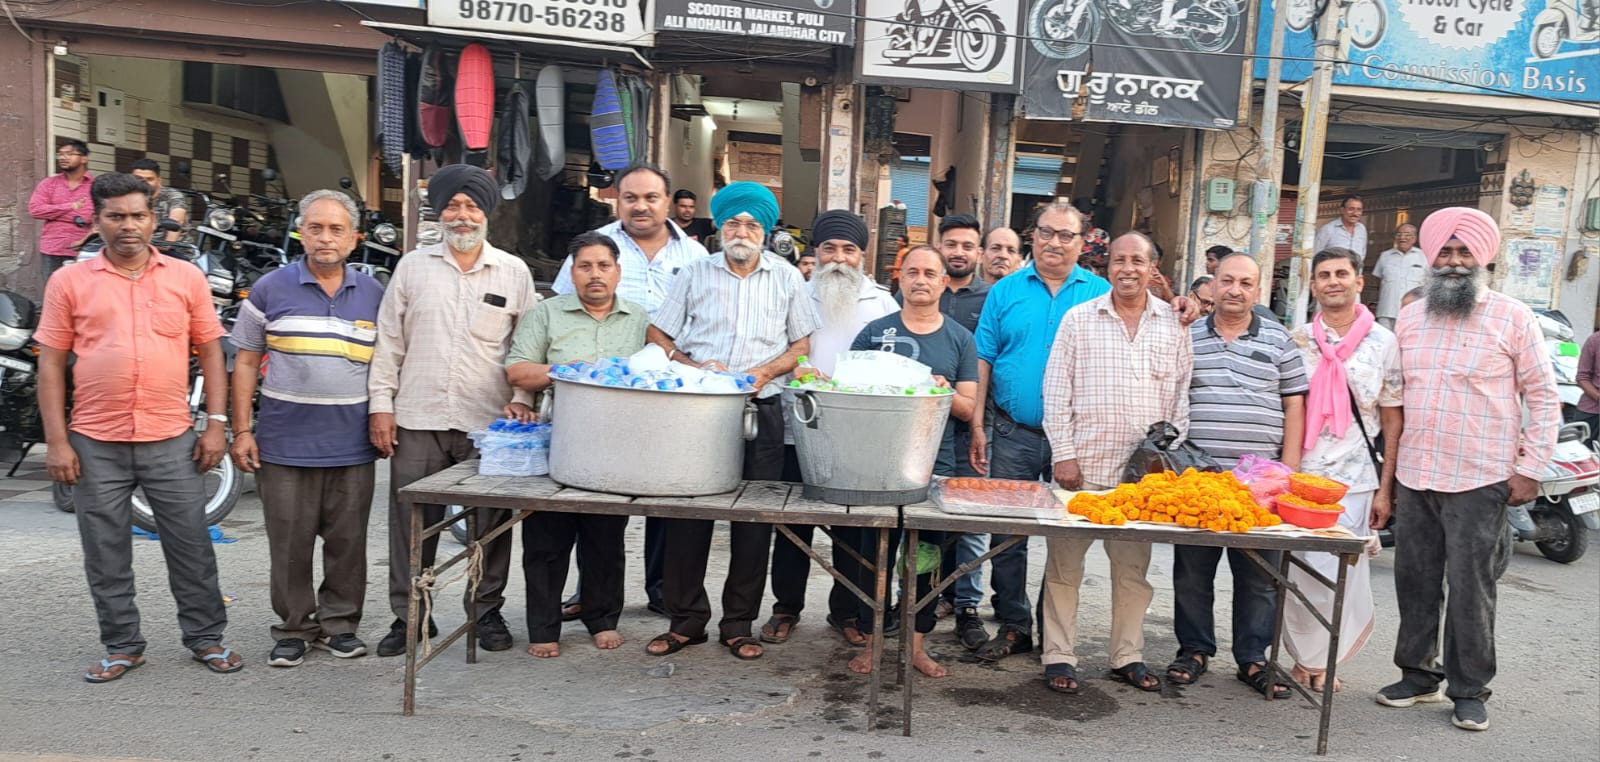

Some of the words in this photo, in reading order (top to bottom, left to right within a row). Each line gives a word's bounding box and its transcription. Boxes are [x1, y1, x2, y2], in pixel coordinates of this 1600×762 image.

[459, 0, 625, 33] 98770-56238
[687, 2, 742, 19] SCOOTER
[744, 7, 795, 25] MARKET,
[797, 12, 825, 27] PULI
[1433, 15, 1447, 34] &
[1455, 17, 1484, 36] Car
[663, 15, 684, 28] ALI
[686, 16, 746, 35] MOHALLA,
[748, 22, 817, 41] JALANDHAR
[818, 29, 847, 44] CITY
[1056, 69, 1113, 104] ਗੁਰੂ
[1114, 72, 1204, 101] ਨਾਨਕ
